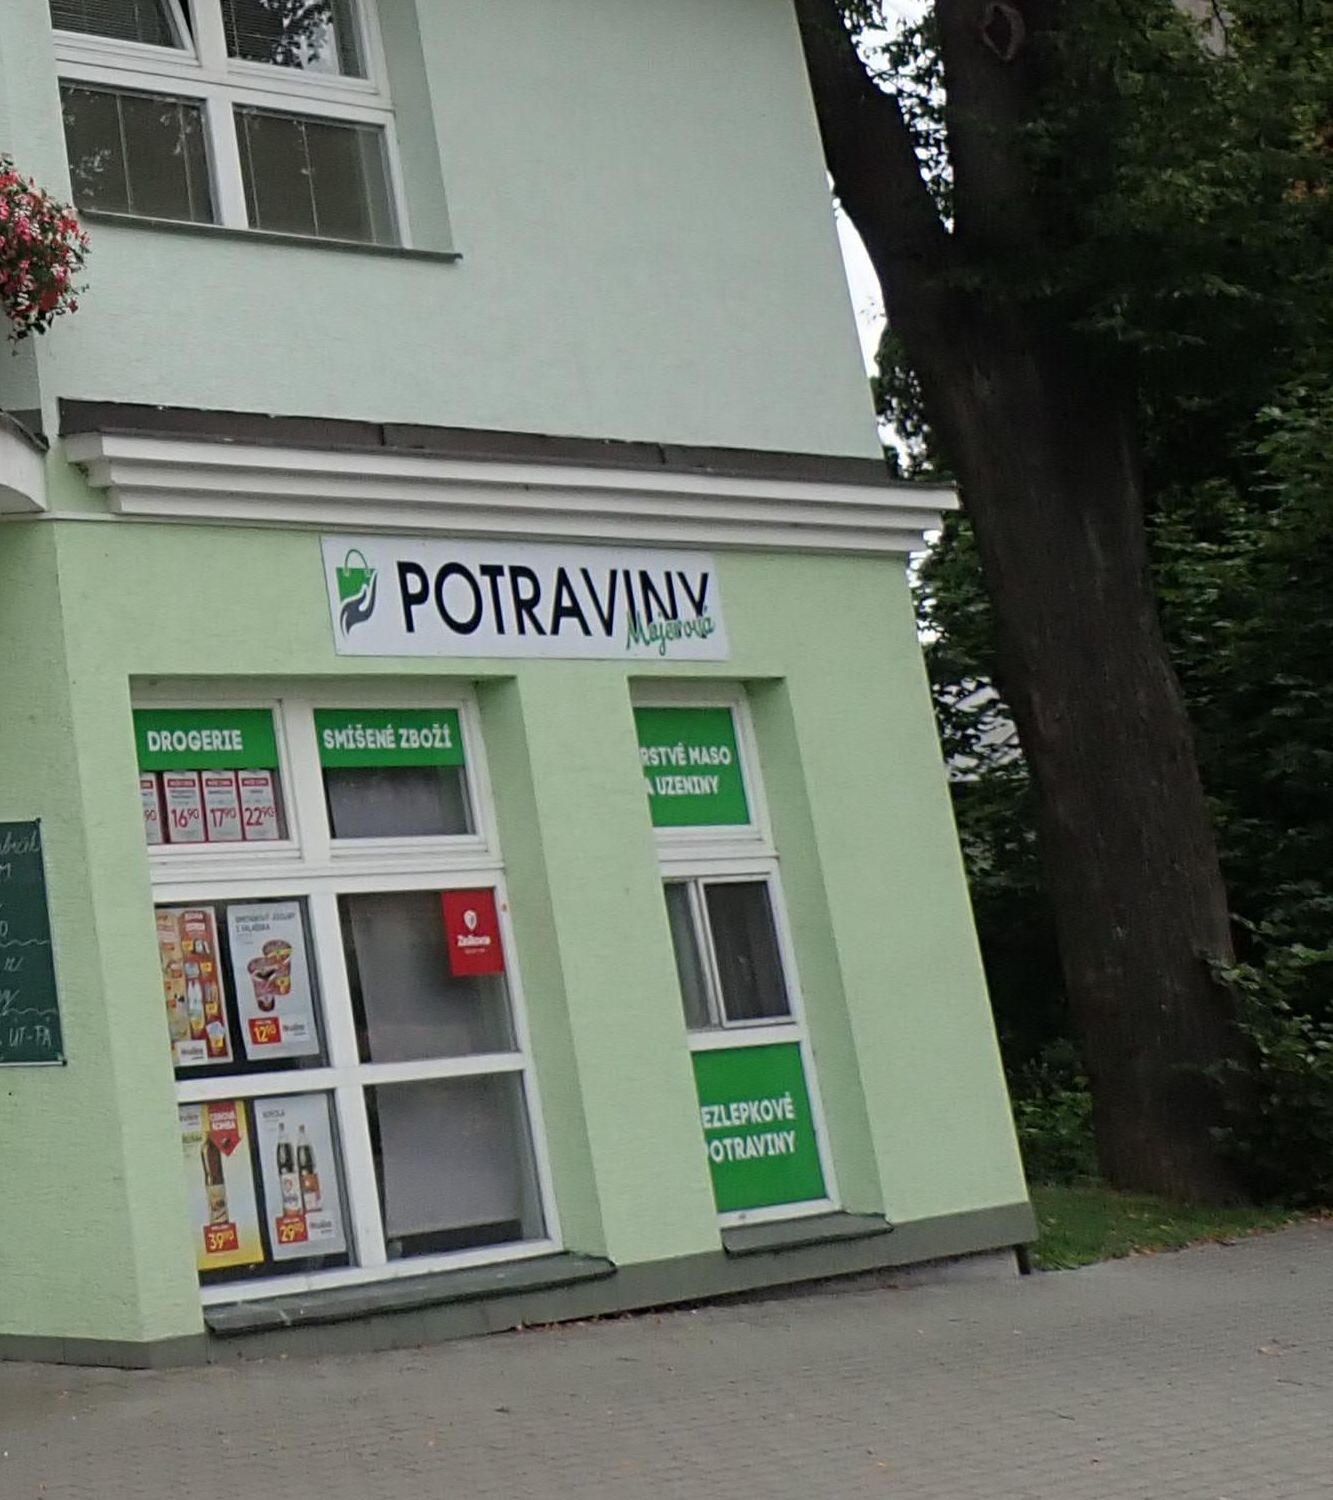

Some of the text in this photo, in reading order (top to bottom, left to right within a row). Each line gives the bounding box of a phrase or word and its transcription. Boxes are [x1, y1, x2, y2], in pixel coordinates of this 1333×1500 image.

[396, 560, 709, 638] POTRAVINY
[147, 729, 243, 751] DROGERIE
[323, 722, 452, 749] SMÍŠENÉ ZBOŽÍ
[688, 745, 731, 765] MASO
[656, 775, 719, 795] UZENINY
[706, 1130, 796, 1163] OTRAVINY
